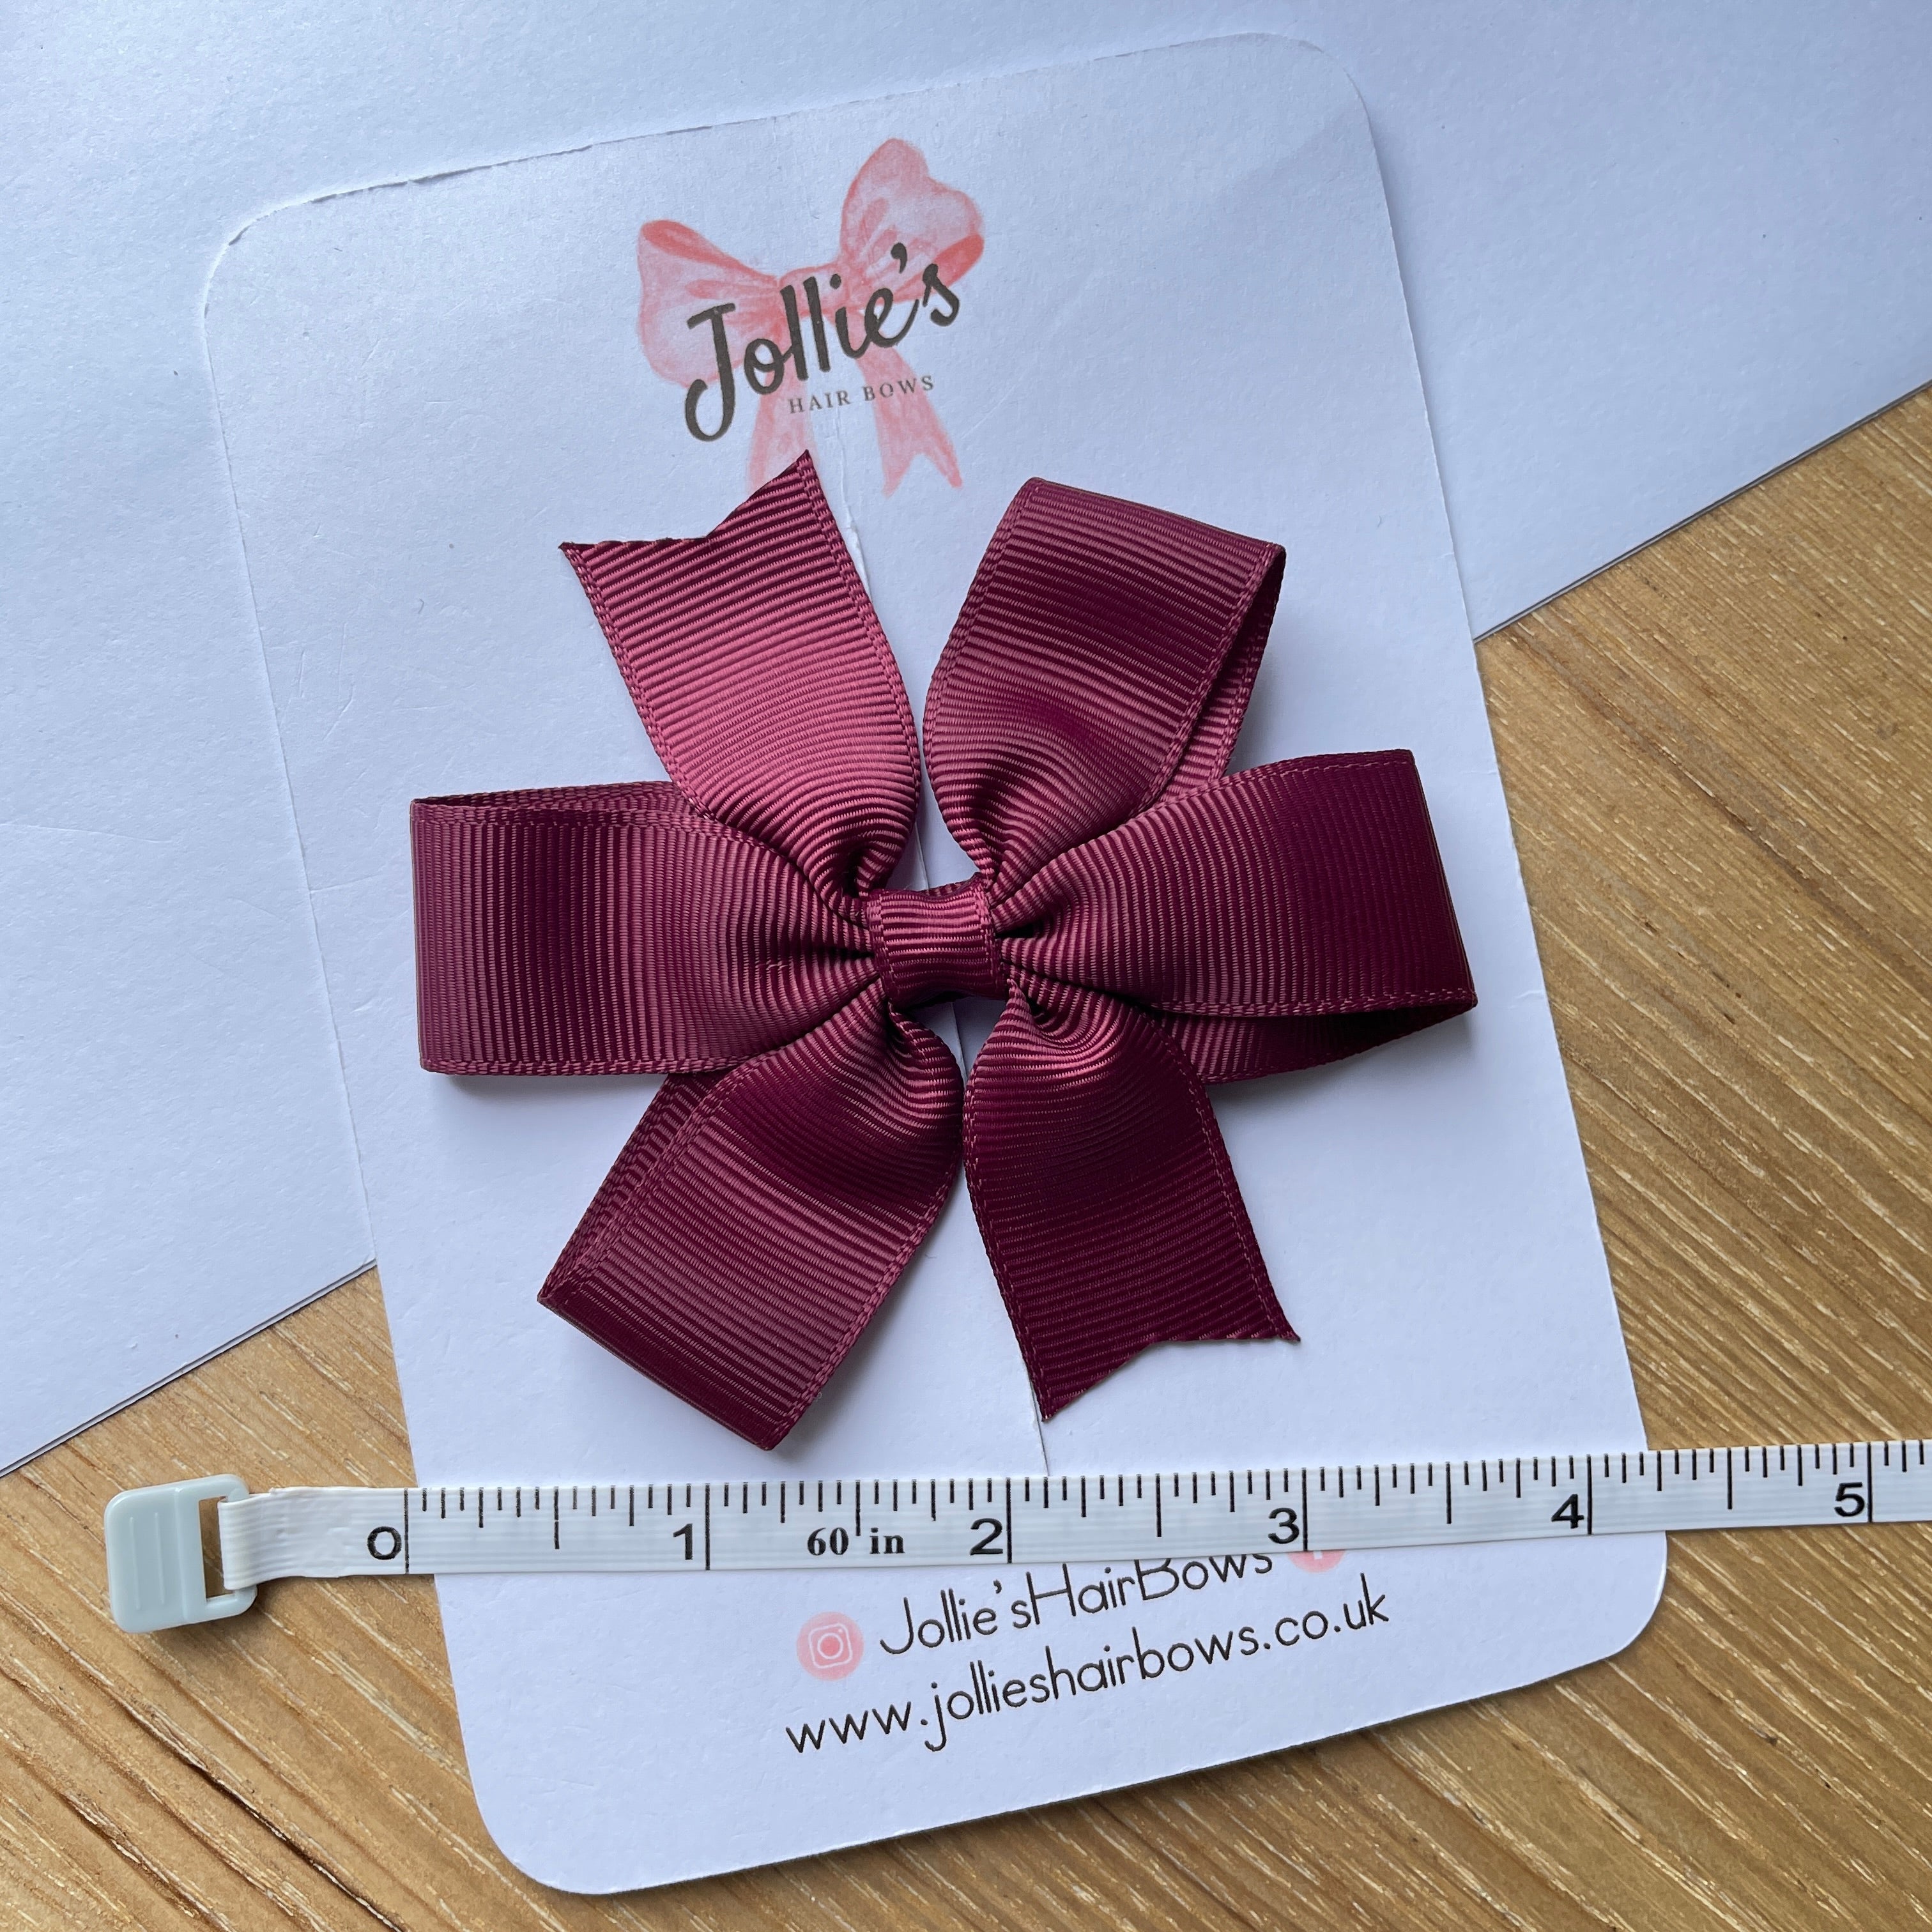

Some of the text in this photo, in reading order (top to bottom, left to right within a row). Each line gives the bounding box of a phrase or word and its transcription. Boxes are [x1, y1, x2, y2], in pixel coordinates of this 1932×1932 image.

[684, 242, 960, 441] Jollie's
[788, 375, 935, 414] HAIR BOWS
[673, 1523, 693, 1560] 1
[806, 1526, 850, 1556] 60
[870, 1526, 905, 1555] in
[969, 1518, 1004, 1556] 2
[1268, 1507, 1300, 1545] 3
[1551, 1494, 1584, 1529] 4
[1834, 1482, 1866, 1518] 5
[785, 1572, 1390, 1753] www.jollieshairbows.co.uk
